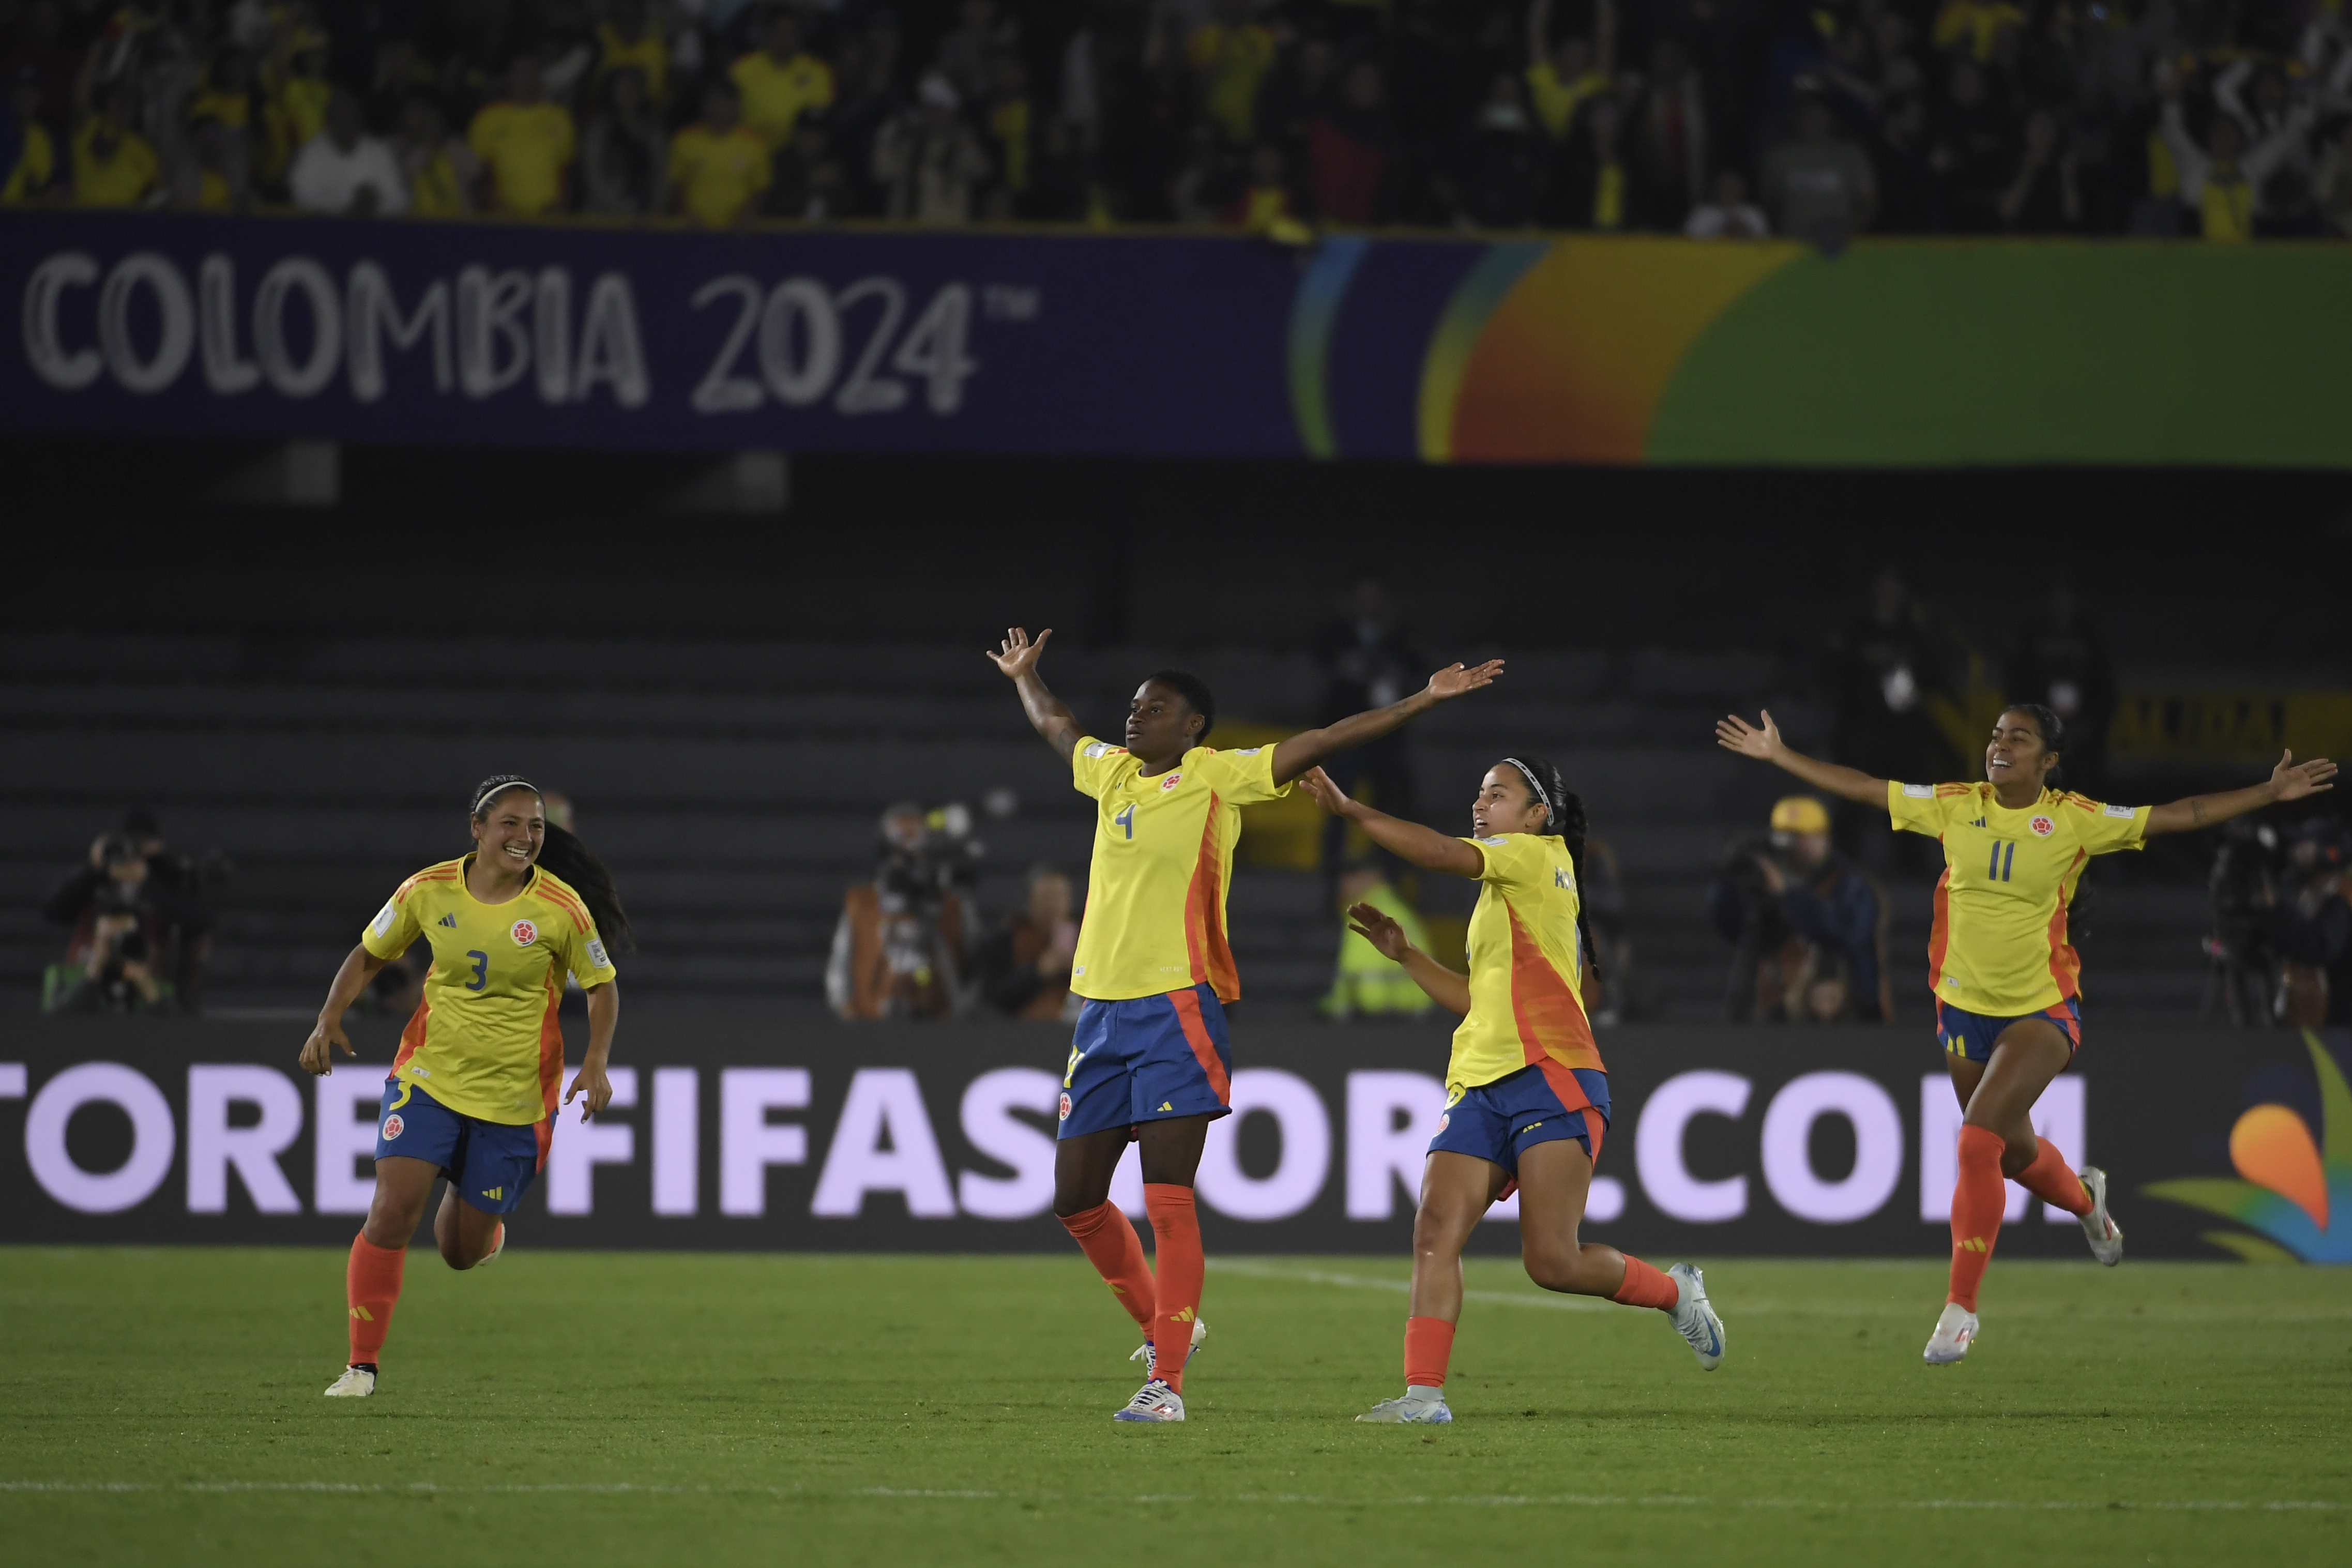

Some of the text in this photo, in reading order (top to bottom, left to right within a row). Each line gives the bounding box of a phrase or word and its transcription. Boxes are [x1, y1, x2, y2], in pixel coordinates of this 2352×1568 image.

[23, 251, 649, 408] COLOMBIA
[691, 274, 977, 415] 2024
[1115, 803, 1136, 840] 4
[1989, 840, 2015, 882] 11
[465, 950, 488, 991] 3
[0, 1061, 2086, 1224] ORE FIFASOR.COM
